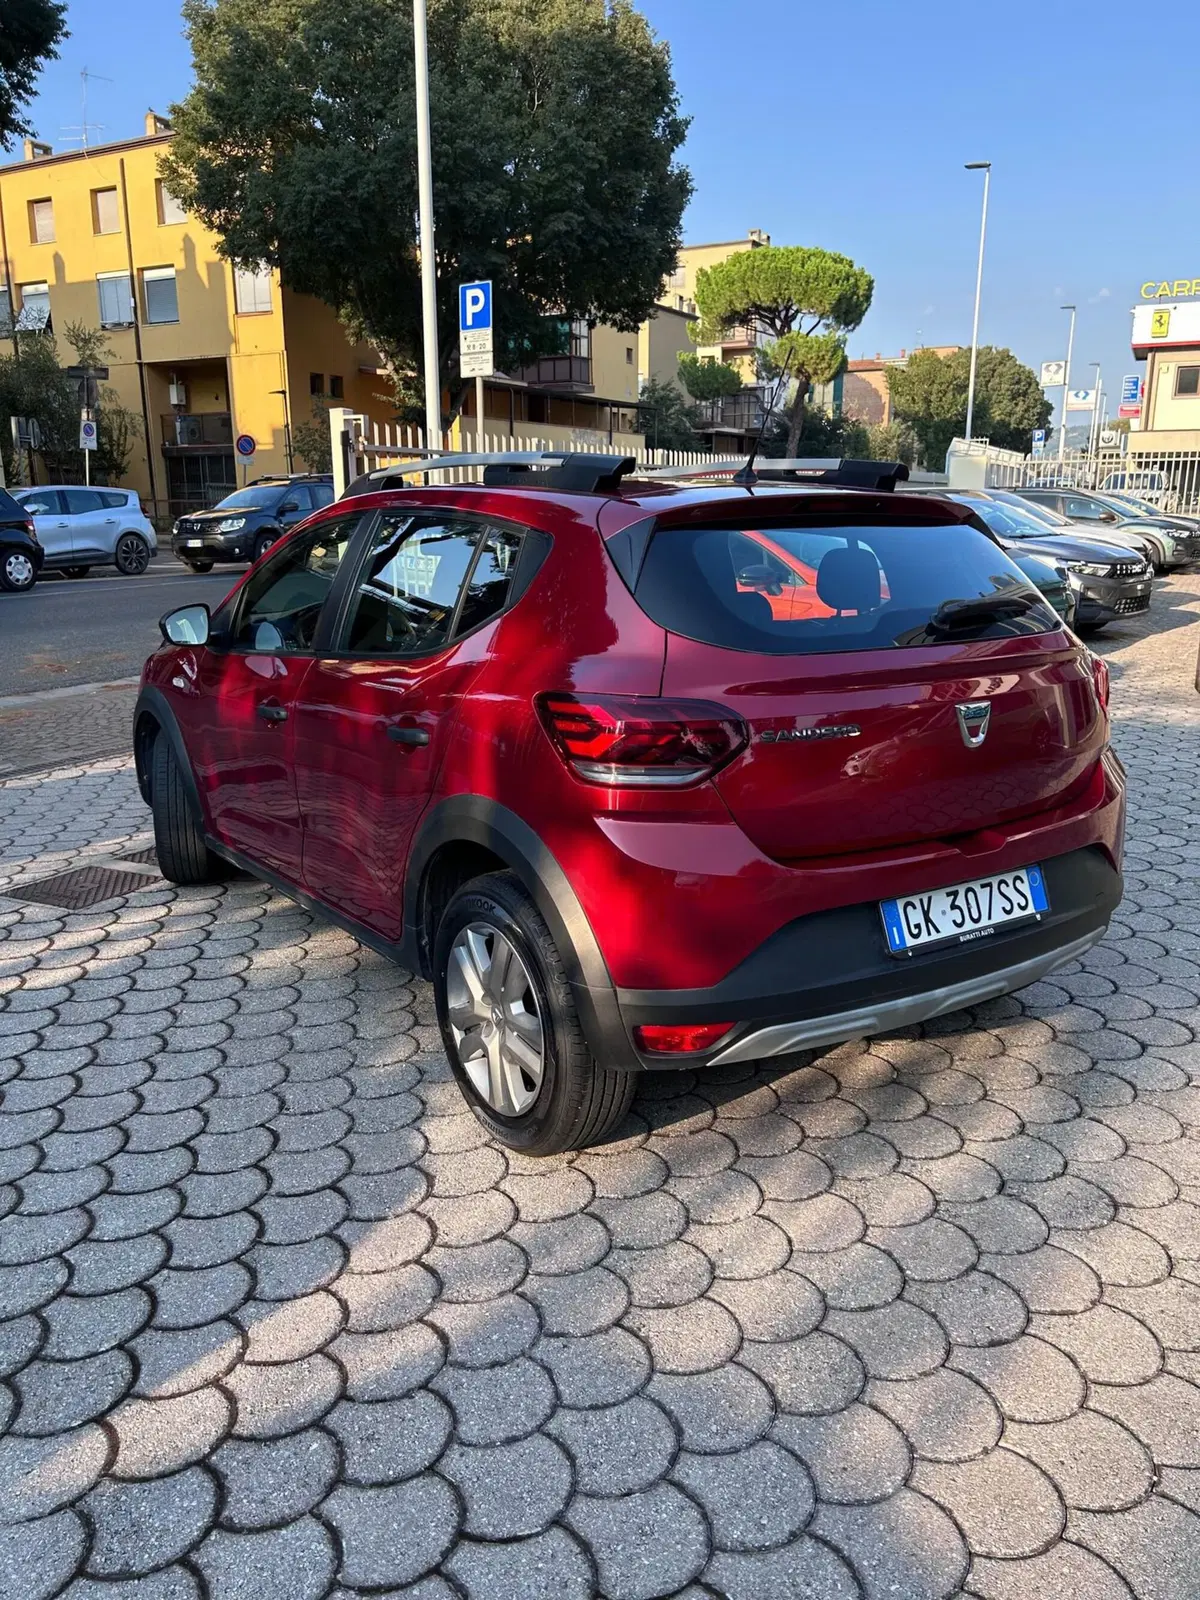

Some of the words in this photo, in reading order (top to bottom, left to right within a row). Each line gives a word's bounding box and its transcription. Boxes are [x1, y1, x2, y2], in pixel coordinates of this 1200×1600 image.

[466, 288, 485, 326] P
[1035, 431, 1043, 441] P
[760, 723, 862, 744] SANDERO
[902, 895, 941, 939] GK
[945, 875, 1029, 928] 307SS
[981, 927, 995, 936] AUTO
